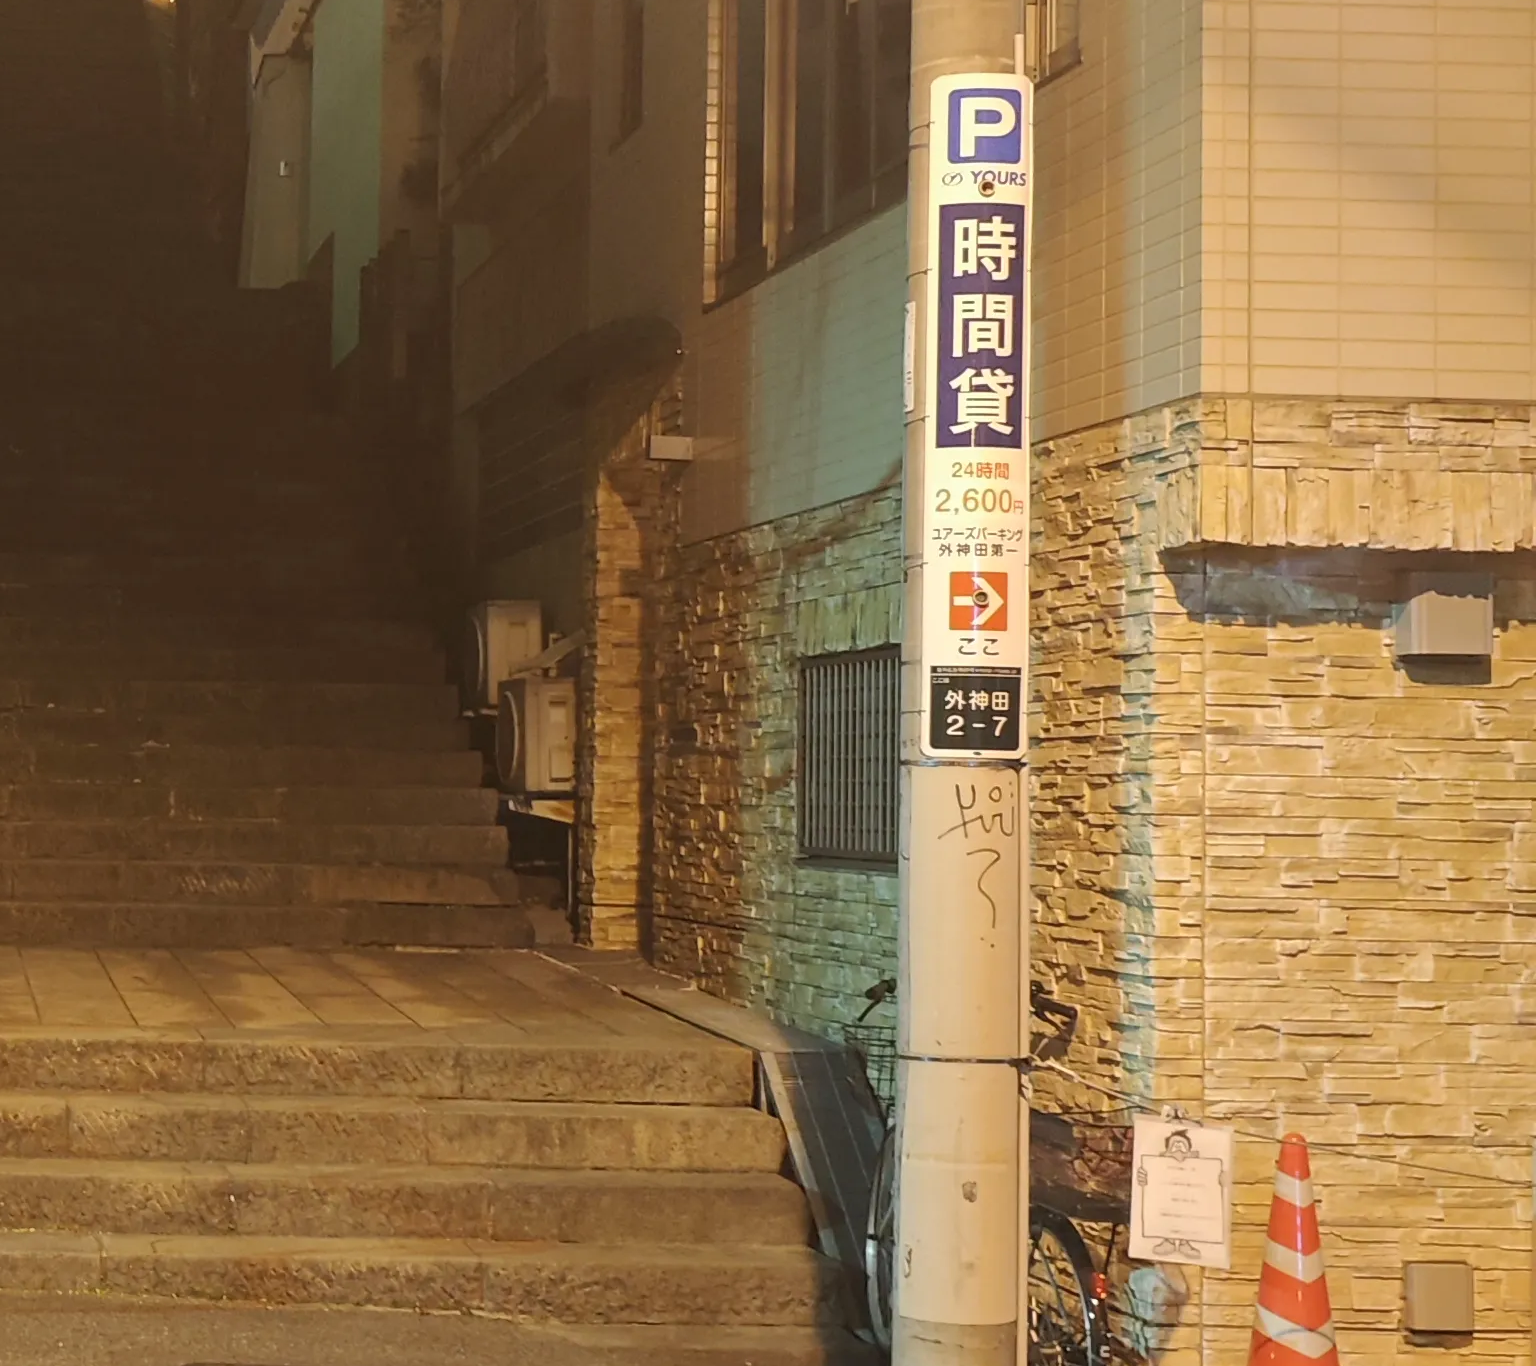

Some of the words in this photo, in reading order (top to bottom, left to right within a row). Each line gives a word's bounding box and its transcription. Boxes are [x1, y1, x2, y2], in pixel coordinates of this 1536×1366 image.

[959, 96, 1017, 158] P
[970, 170, 1027, 187] YOURS
[948, 214, 1018, 436] 時間貸
[951, 461, 1010, 480] 24時間
[935, 488, 1024, 515] 2,600円
[938, 542, 1019, 557] 外神田第一
[957, 637, 1001, 657] ここ
[944, 689, 1010, 711] 外神田
[946, 714, 1009, 737] 2-7
